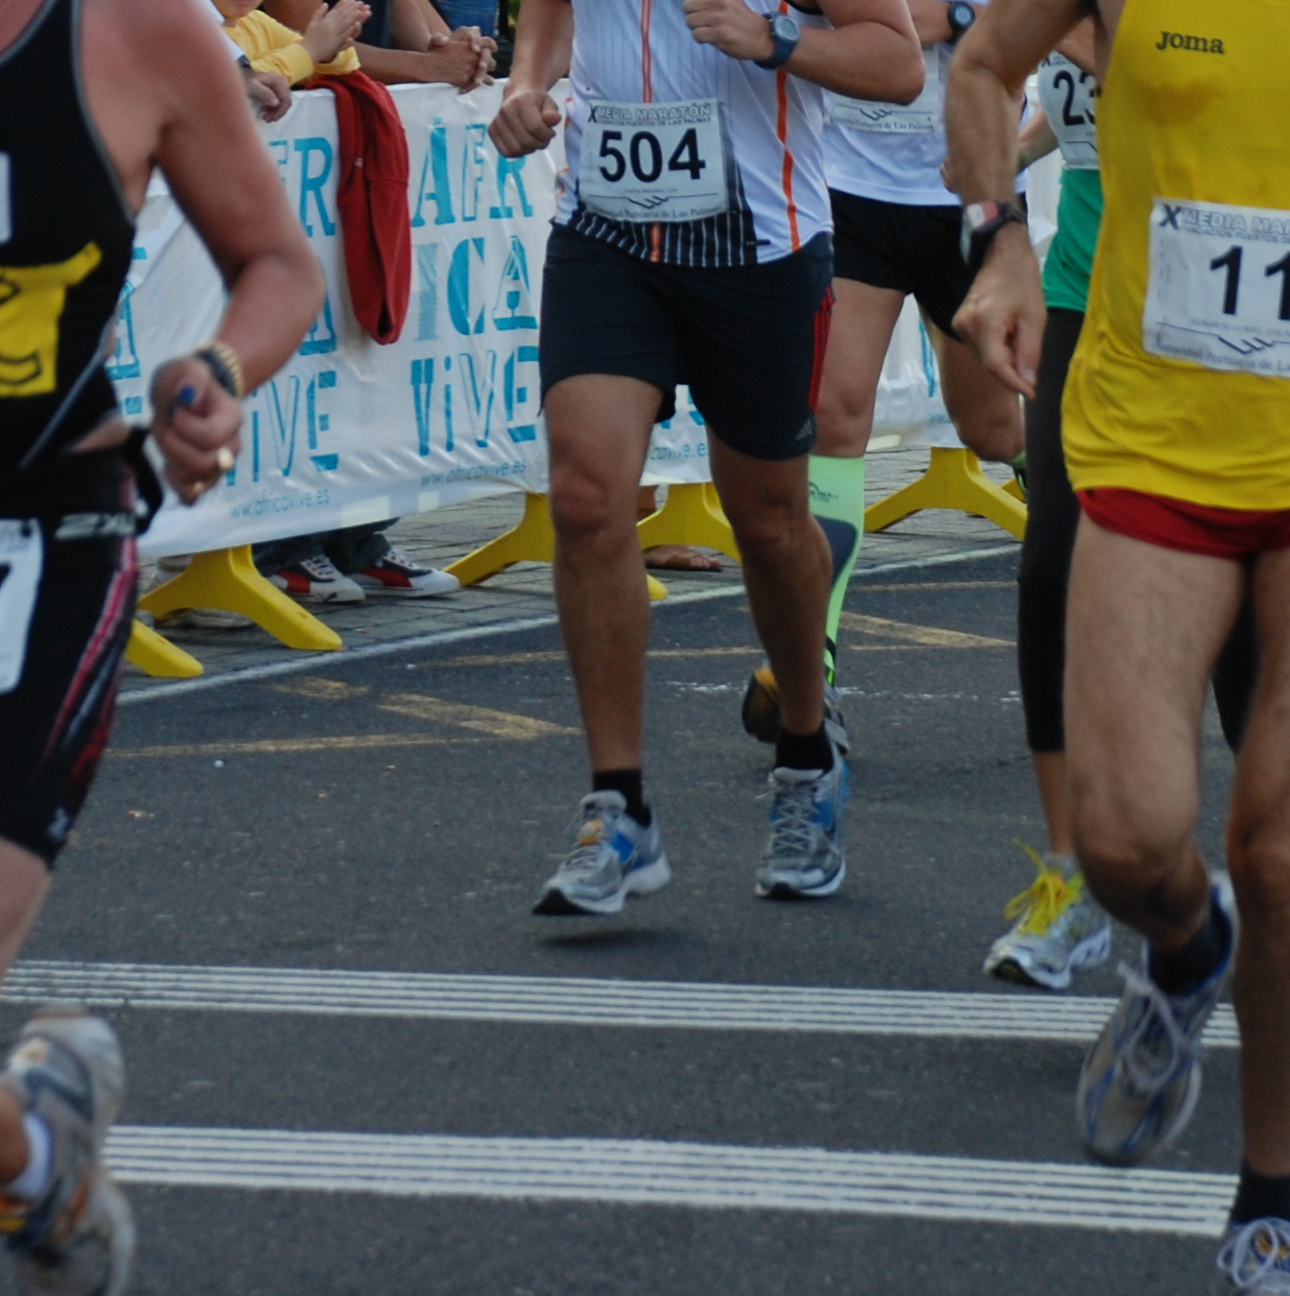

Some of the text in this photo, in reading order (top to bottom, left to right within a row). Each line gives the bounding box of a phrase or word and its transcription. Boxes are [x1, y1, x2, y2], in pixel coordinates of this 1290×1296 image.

[599, 128, 706, 183] 504
[1159, 204, 1182, 231] X
[1182, 207, 1249, 233] MEDIA
[412, 235, 539, 341] ICA
[1259, 357, 1273, 371] de
